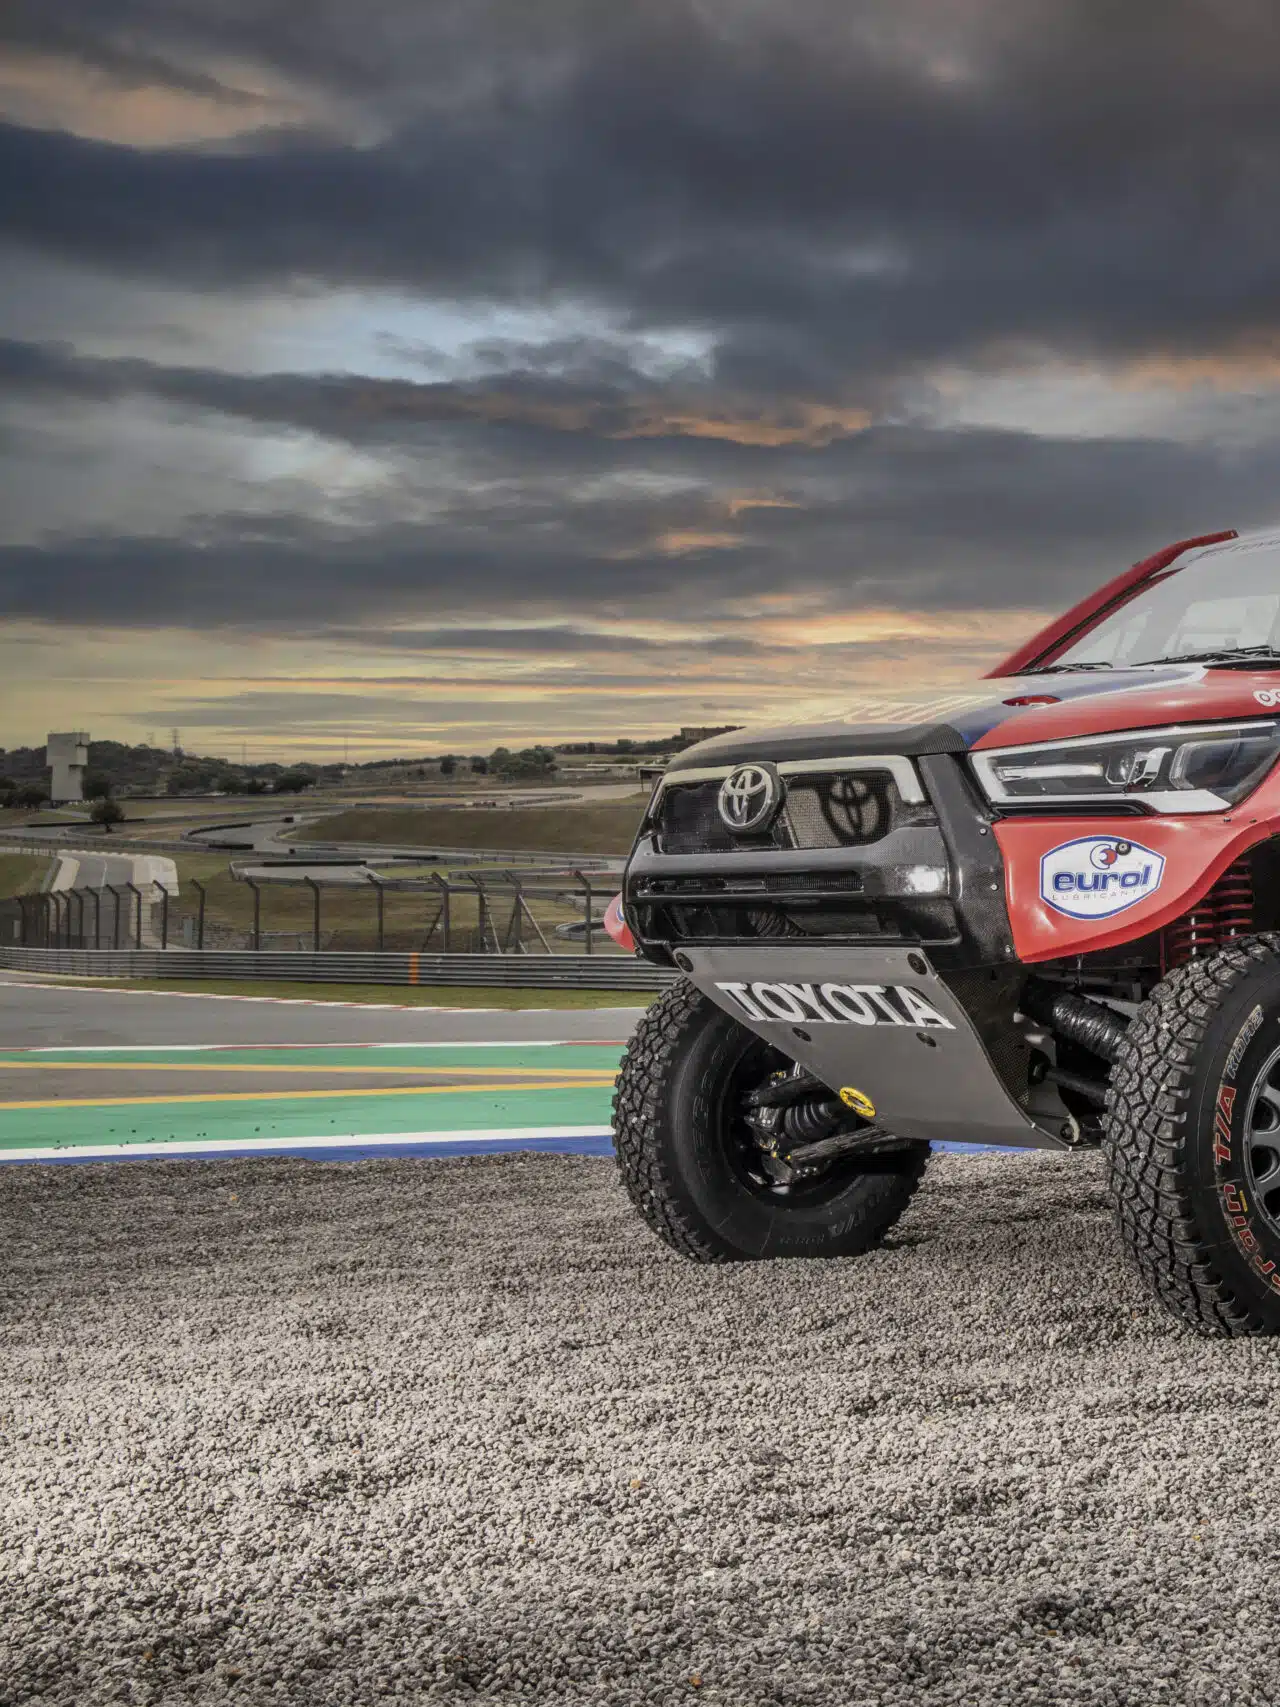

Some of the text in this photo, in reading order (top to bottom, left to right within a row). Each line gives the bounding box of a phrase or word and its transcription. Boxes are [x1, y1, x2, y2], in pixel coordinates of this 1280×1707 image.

[1052, 863, 1153, 892] eurol
[713, 982, 957, 1030] TOYOTA
[1214, 1084, 1237, 1166] T/A
